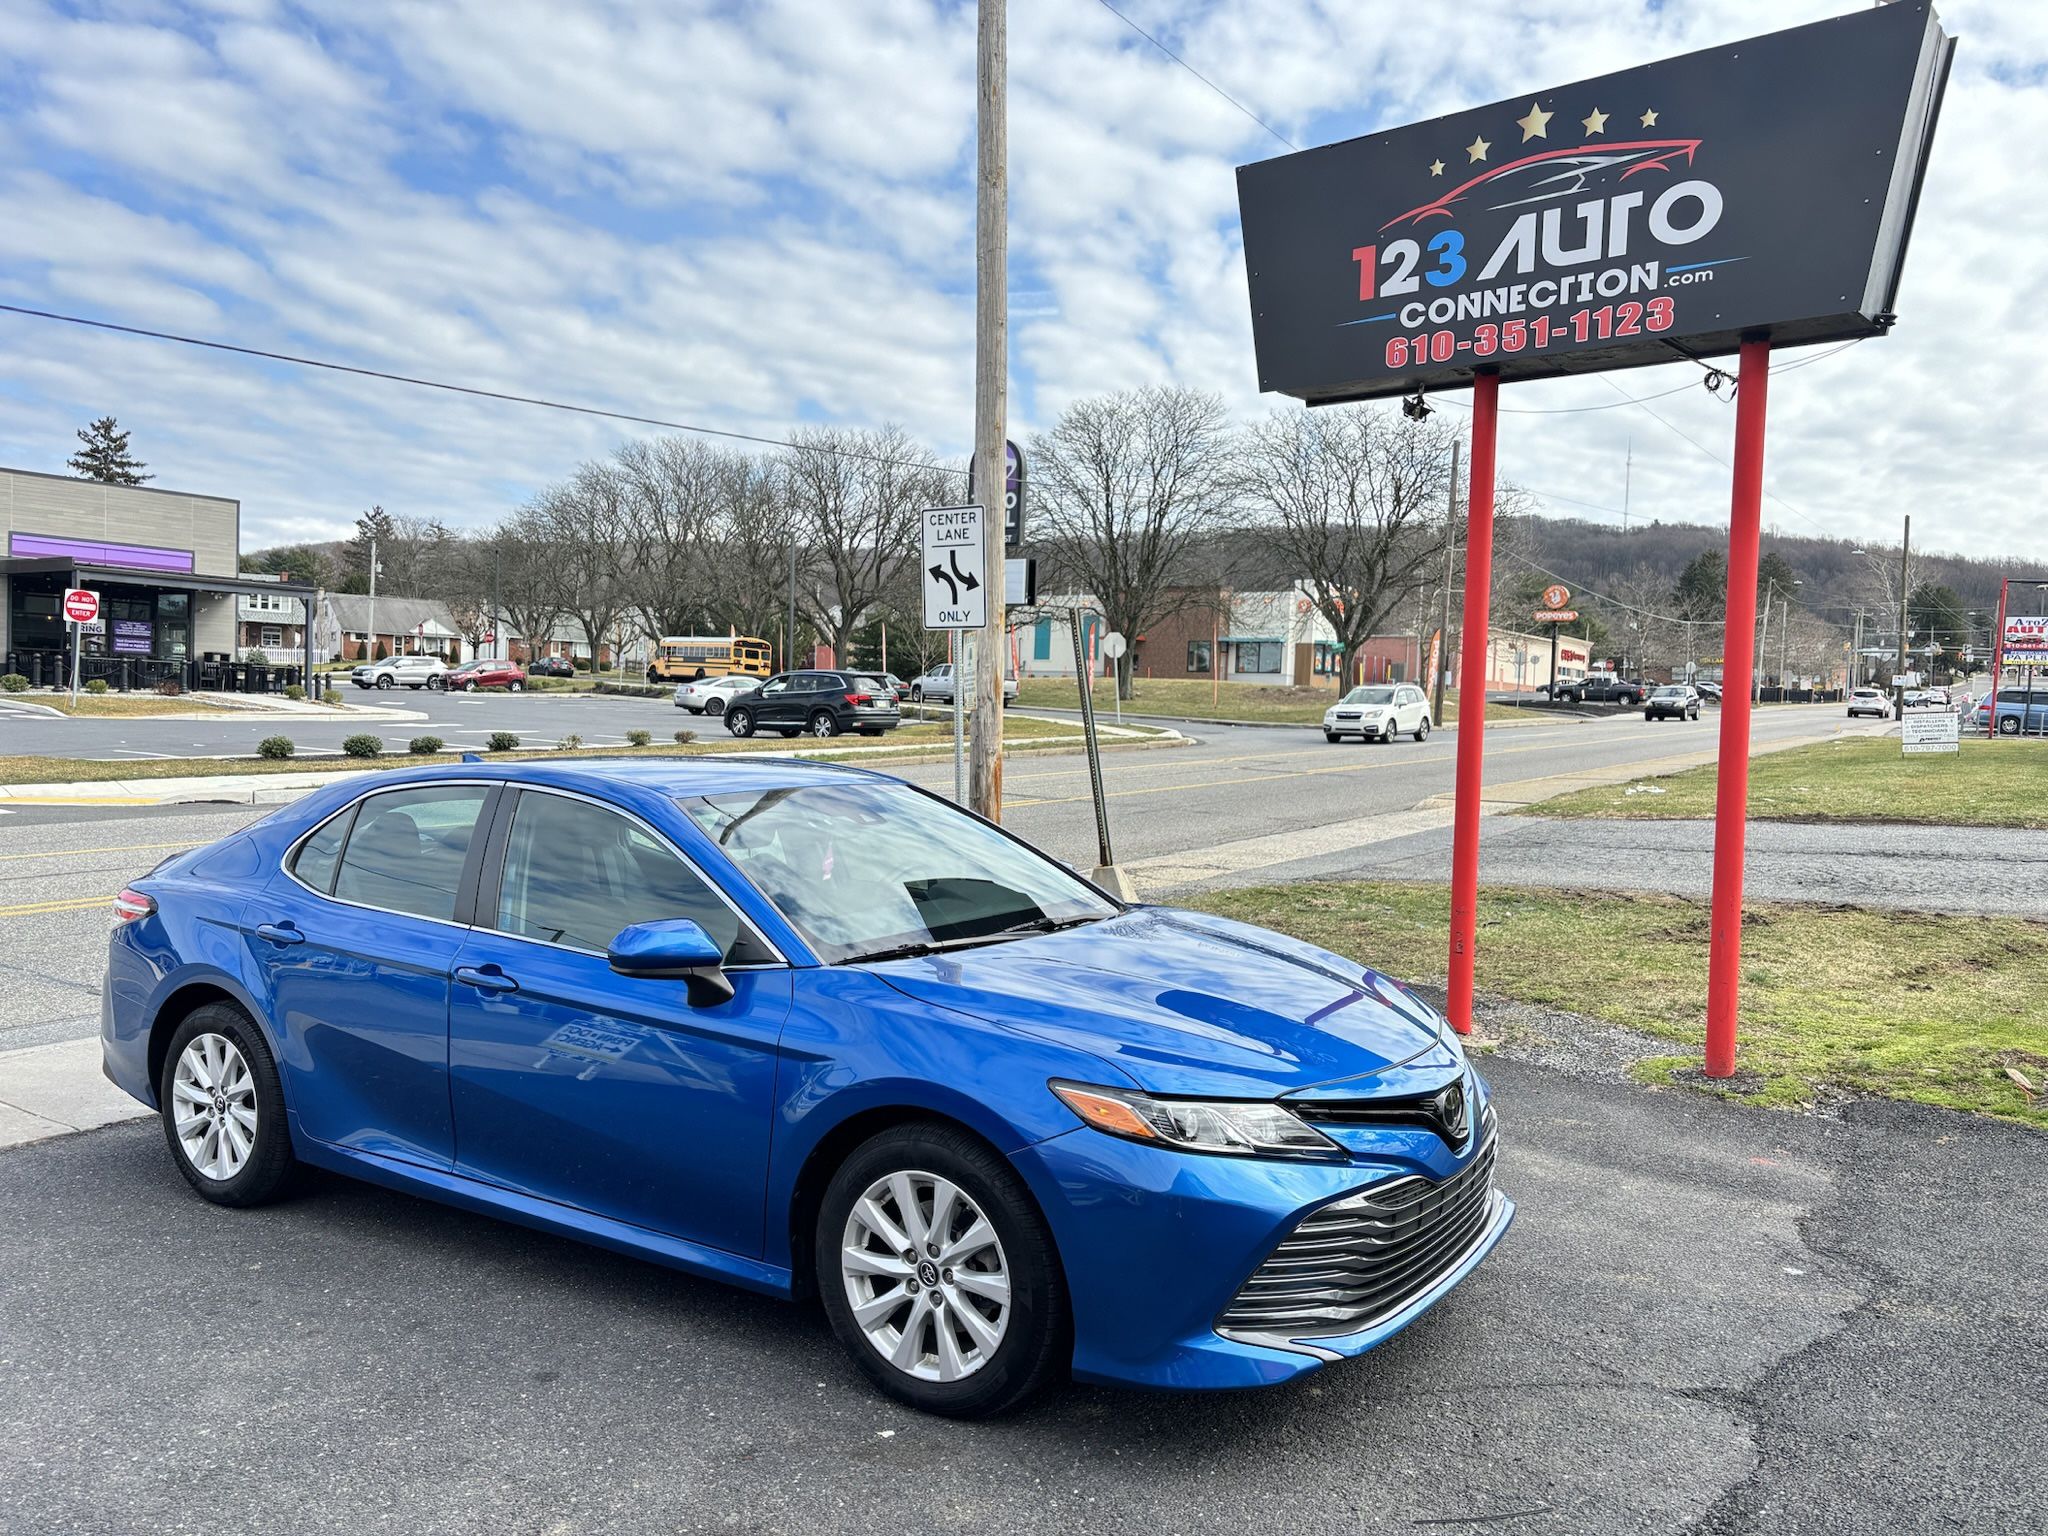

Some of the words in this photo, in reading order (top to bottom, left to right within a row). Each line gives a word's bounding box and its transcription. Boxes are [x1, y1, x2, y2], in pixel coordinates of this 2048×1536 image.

[1352, 229, 1468, 302] 123
[1475, 180, 1724, 282] AUTO
[1399, 261, 1660, 329] CONNECTION
[1385, 296, 1676, 369] 610-351-1123
[929, 511, 977, 526] CENTER
[937, 528, 970, 541] LANE
[71, 609, 91, 617] ENTER
[938, 610, 971, 623] ONLY
